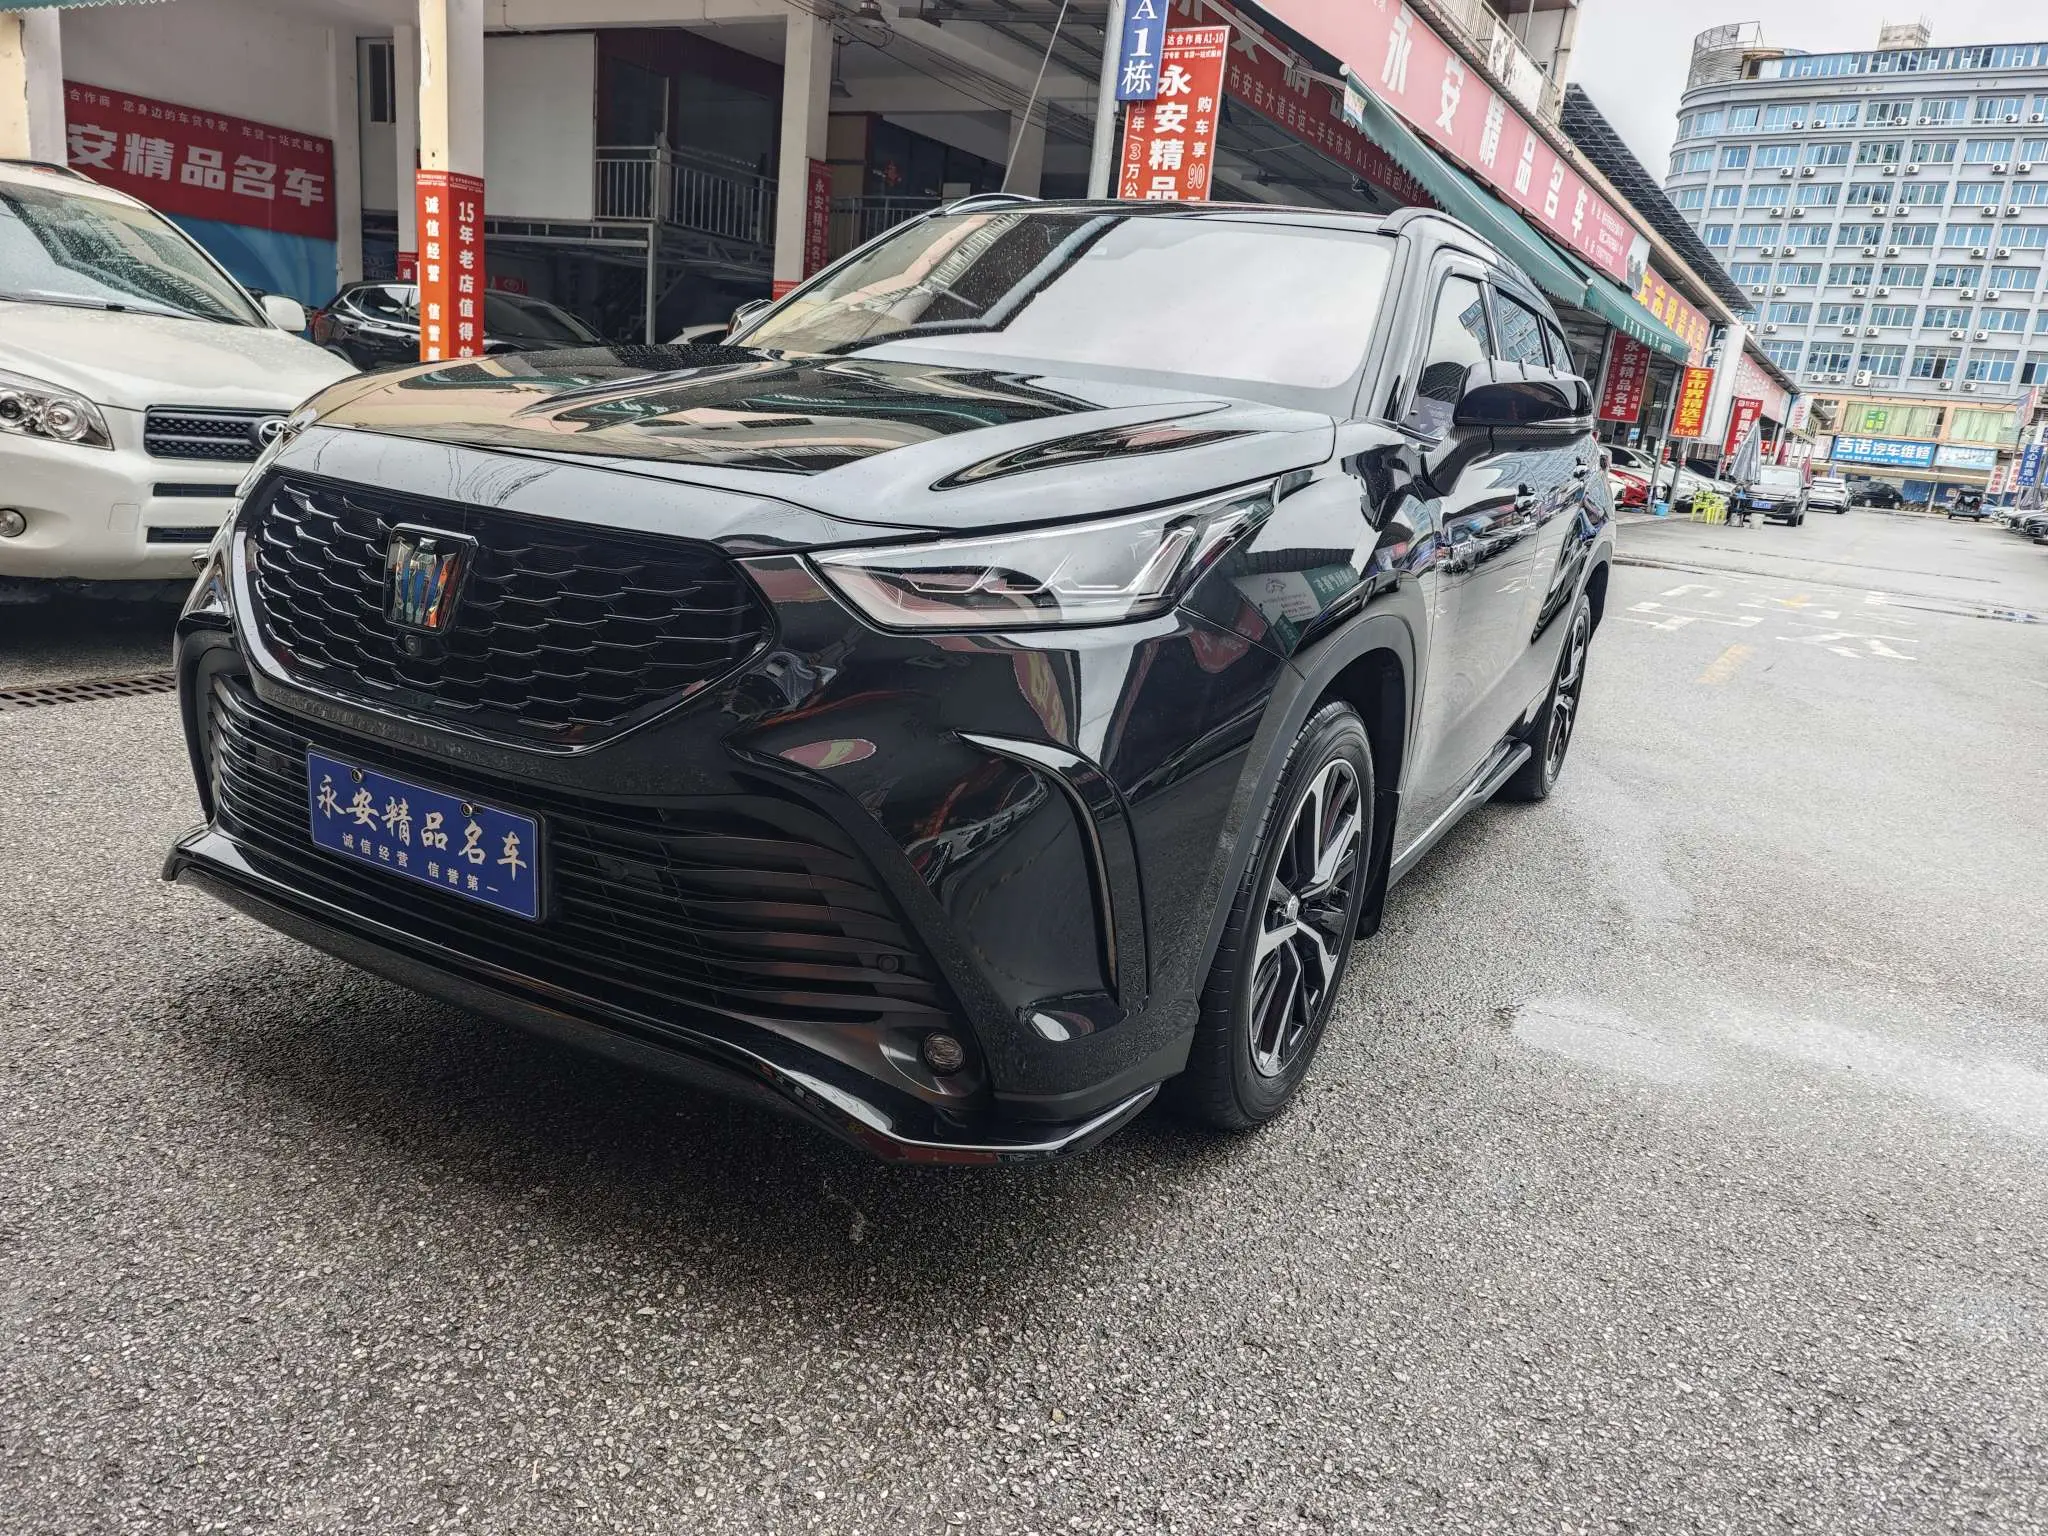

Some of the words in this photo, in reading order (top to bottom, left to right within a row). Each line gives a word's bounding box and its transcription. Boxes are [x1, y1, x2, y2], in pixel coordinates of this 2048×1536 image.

[1121, 0, 1158, 95] A1栋
[69, 89, 111, 107] 合作商
[122, 99, 229, 132] 您身边的车贷专家
[242, 126, 325, 154] 车贷一站式服务
[1146, 64, 1192, 200] 永安精品
[1187, 96, 1213, 200] 购车享90
[1224, 62, 1352, 161] 市安吉大道吉运二手车市场
[1381, 6, 1588, 239] 永安精品名车
[67, 123, 325, 208] 安精品名车
[425, 196, 440, 283] 诚信经营
[458, 201, 475, 358] 15年老店值得信
[1610, 340, 1640, 416] 永安精品名车
[1836, 437, 1931, 459] 吉诺汽车维修
[316, 774, 528, 881] 永安精品名车
[342, 832, 409, 868] 诚信经营
[427, 861, 499, 892] 信誉第一
